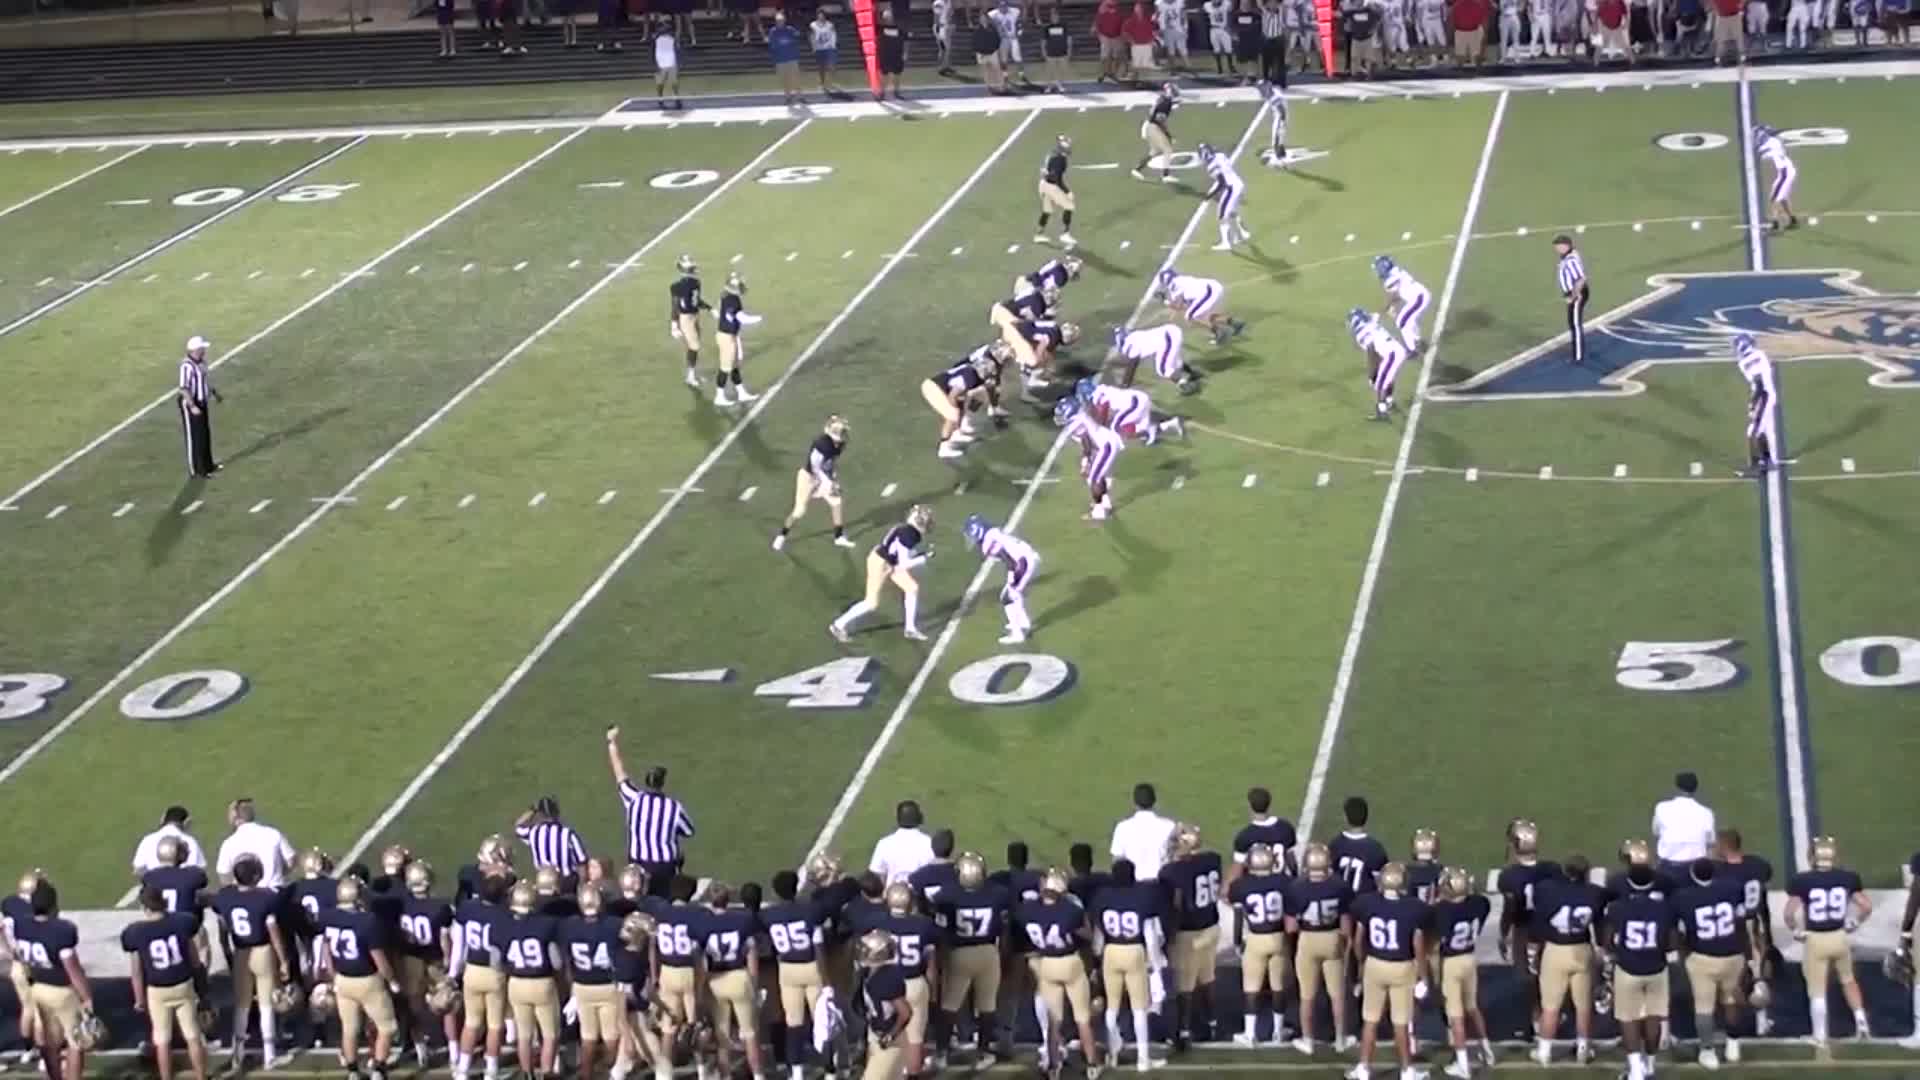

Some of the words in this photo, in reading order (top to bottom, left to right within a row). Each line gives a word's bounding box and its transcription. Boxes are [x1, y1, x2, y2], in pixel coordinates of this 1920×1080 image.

[754, 653, 1068, 707] 40
[1195, 870, 1219, 908] 66
[1339, 856, 1364, 892] 77
[1246, 891, 1282, 924] 39
[1303, 898, 1339, 926] 45
[1550, 905, 1592, 934] 43
[1695, 901, 1734, 939] 52
[1808, 886, 1847, 922] 29
[231, 908, 251, 936] 6
[770, 920, 810, 953] 85
[956, 907, 992, 937] 57
[1026, 922, 1066, 949] 84
[1369, 916, 1399, 950] 61
[1450, 918, 1479, 949] 21
[1625, 920, 1657, 950] 51
[150, 935, 183, 970] 91
[325, 926, 359, 959] 73
[507, 938, 543, 968] 49
[657, 923, 691, 955] 66
[890, 935, 920, 966] 5
[570, 942, 612, 971] 54
